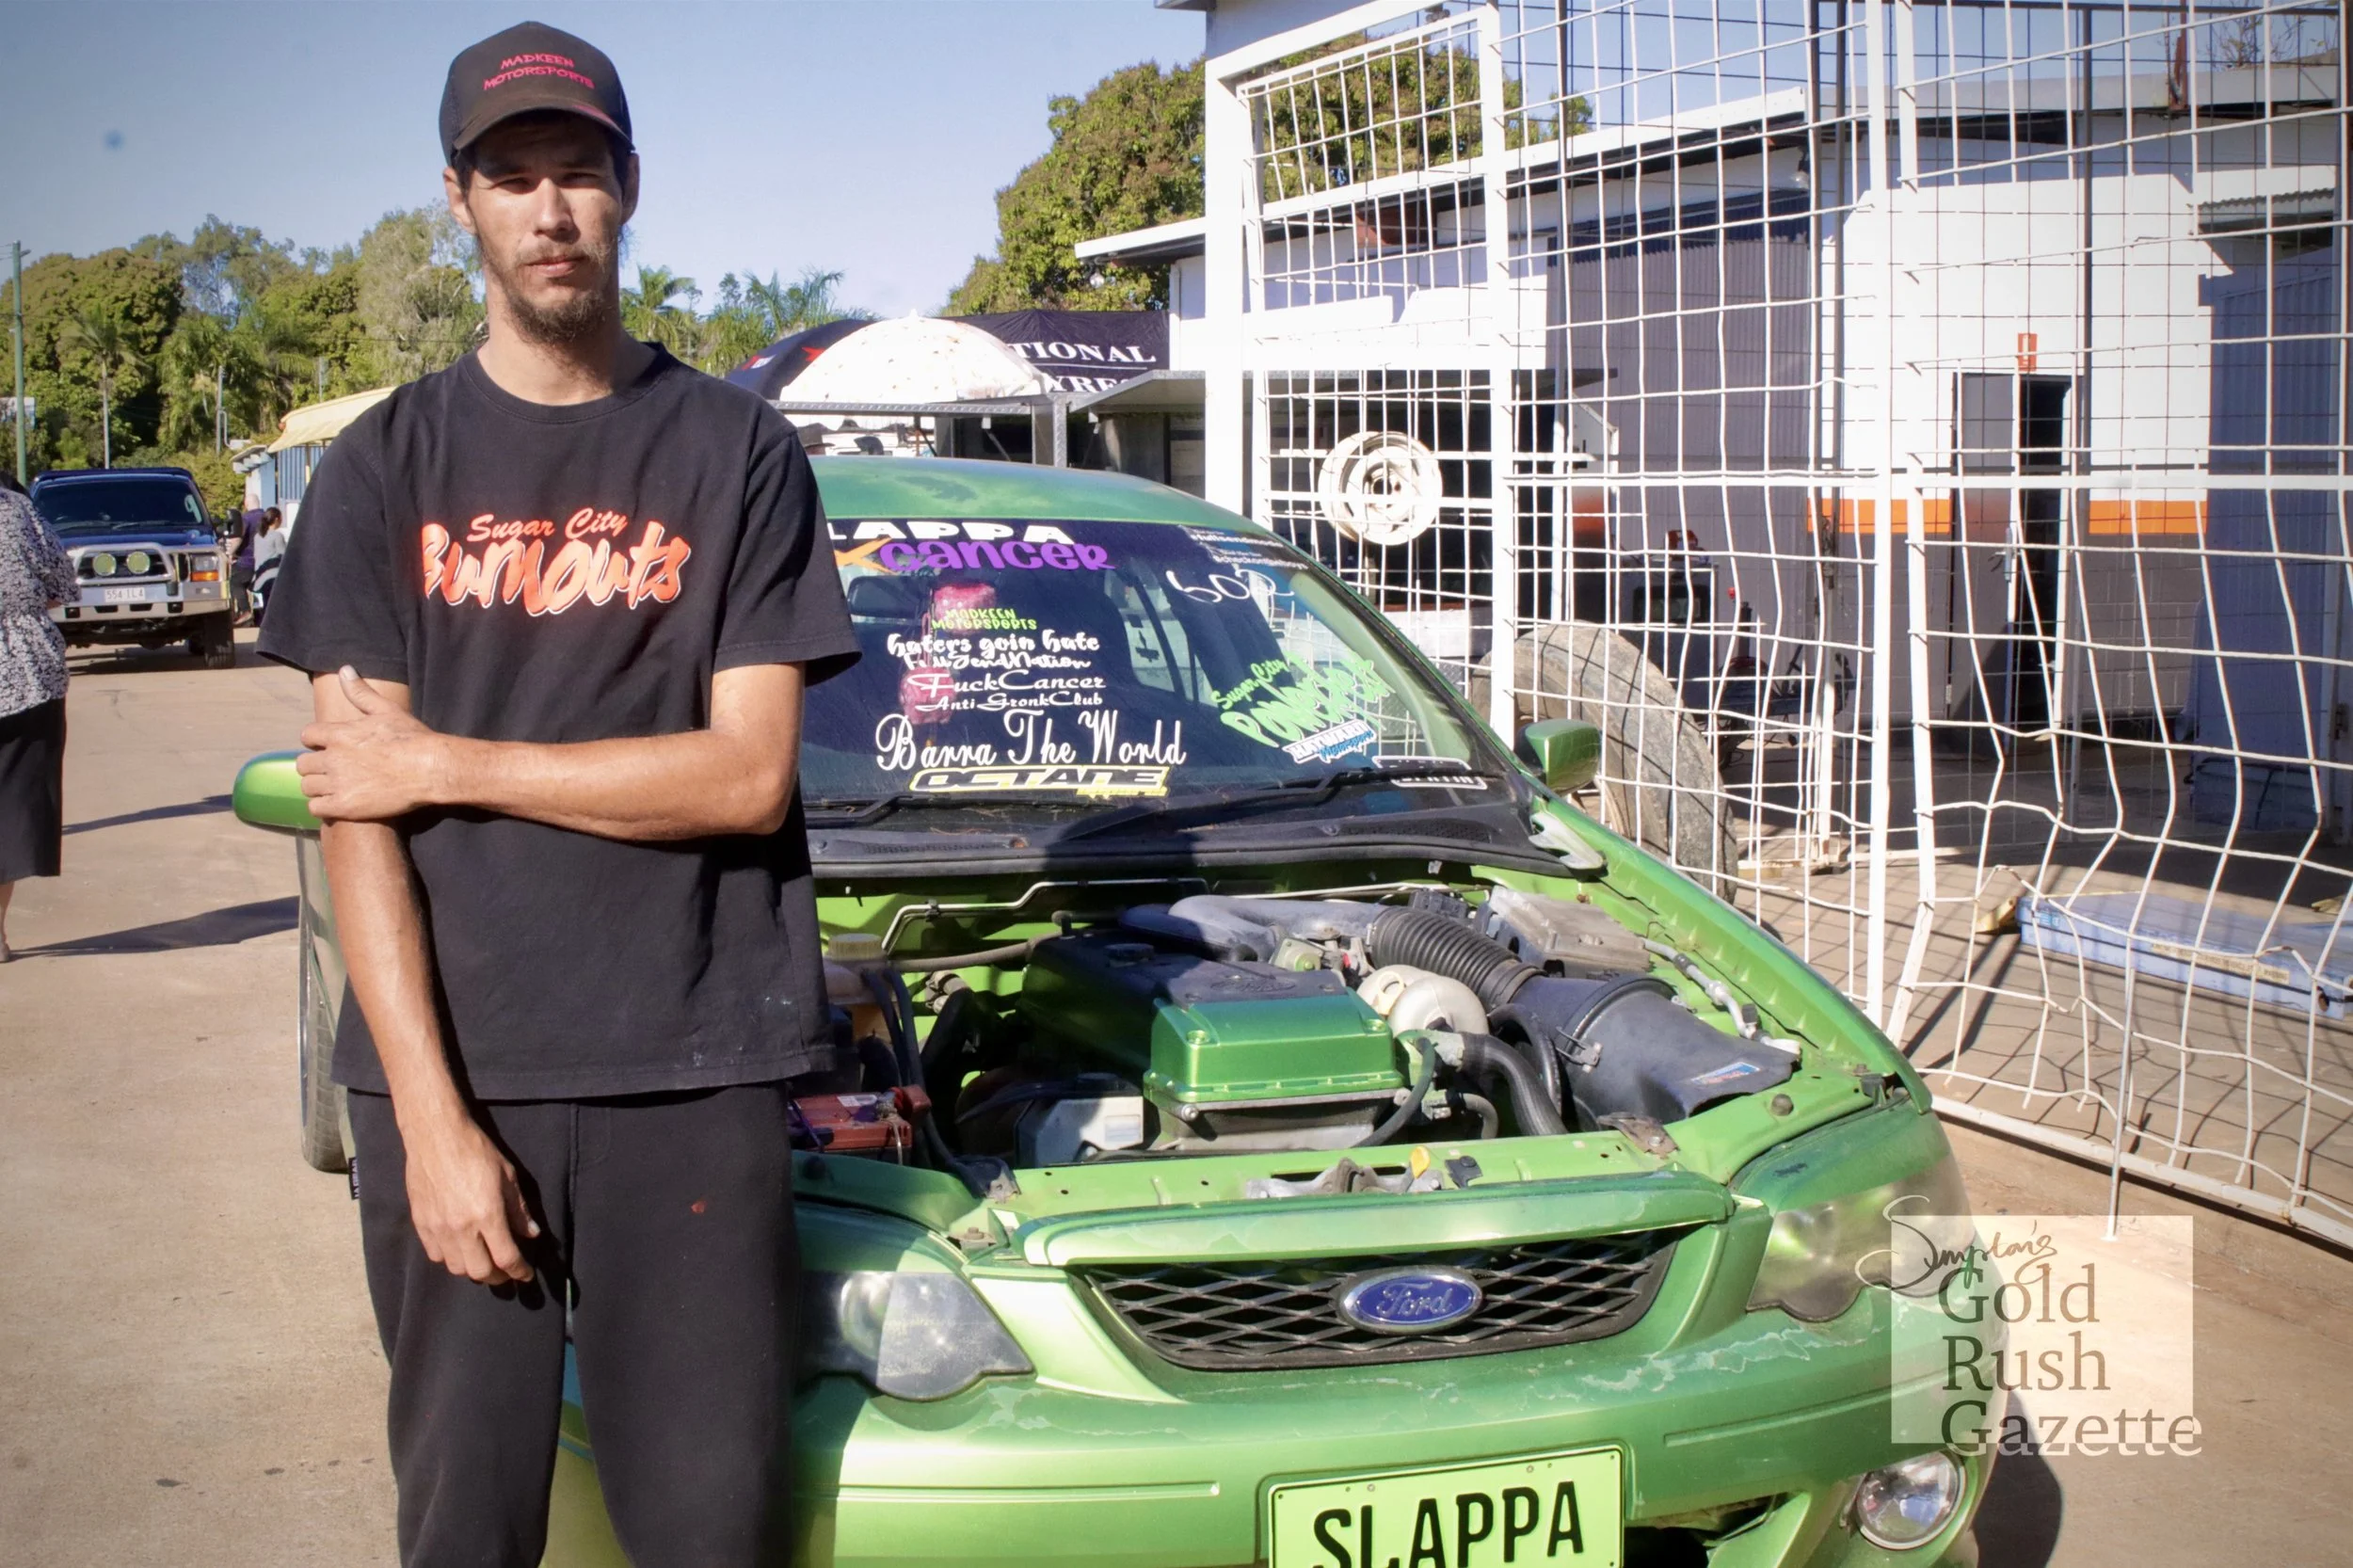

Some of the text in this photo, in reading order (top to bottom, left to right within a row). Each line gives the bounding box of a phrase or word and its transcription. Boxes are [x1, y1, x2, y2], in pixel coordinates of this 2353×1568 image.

[483, 65, 595, 90] MOTORSPORTS
[500, 54, 575, 70] MADKEEN
[466, 506, 628, 543] Sugar City
[887, 629, 1100, 658] haters goin hate
[1210, 678, 1260, 710] Sugar
[875, 709, 1187, 771] Barra The World
[1376, 1282, 1453, 1318] Ford
[1312, 1480, 1584, 1568] SLAPPA
